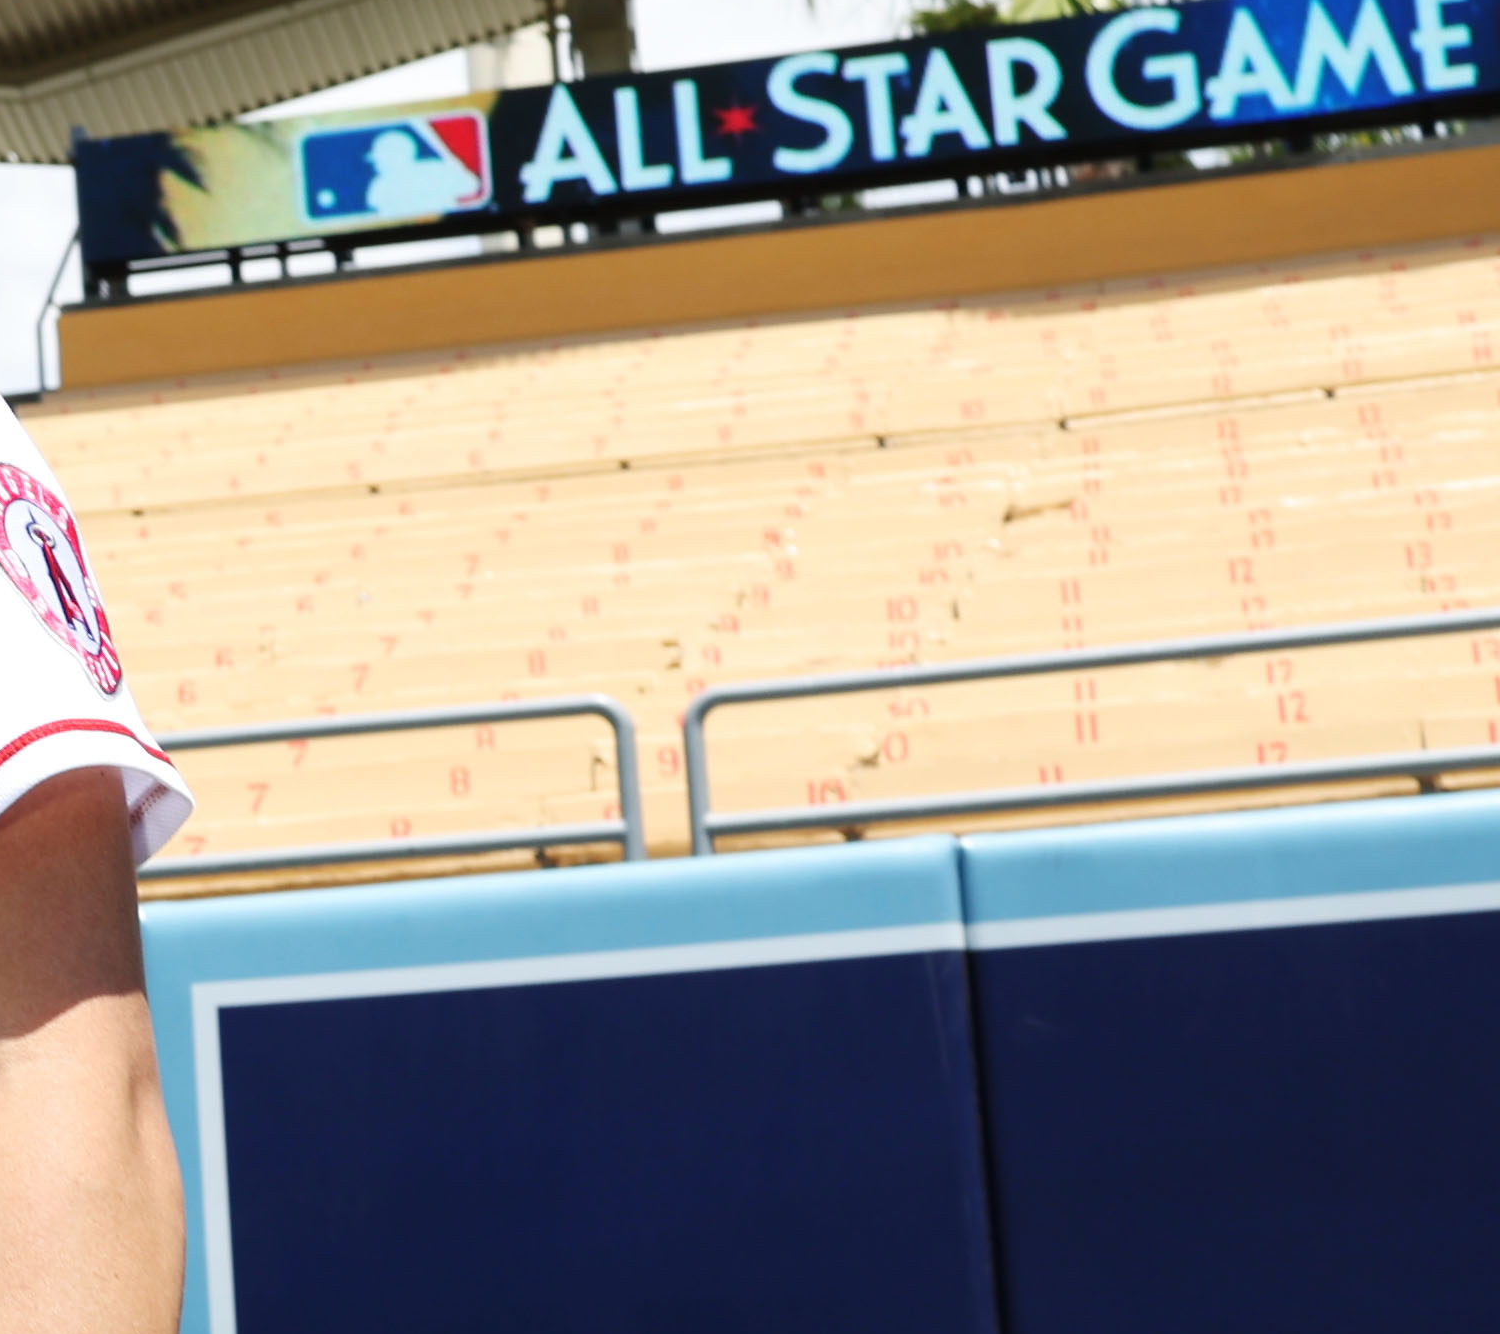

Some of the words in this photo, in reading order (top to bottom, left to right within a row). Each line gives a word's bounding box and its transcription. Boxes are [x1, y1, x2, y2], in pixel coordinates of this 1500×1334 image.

[518, 82, 733, 203] ALL
[766, 36, 1067, 173] STAR
[1276, 690, 1311, 725] 12
